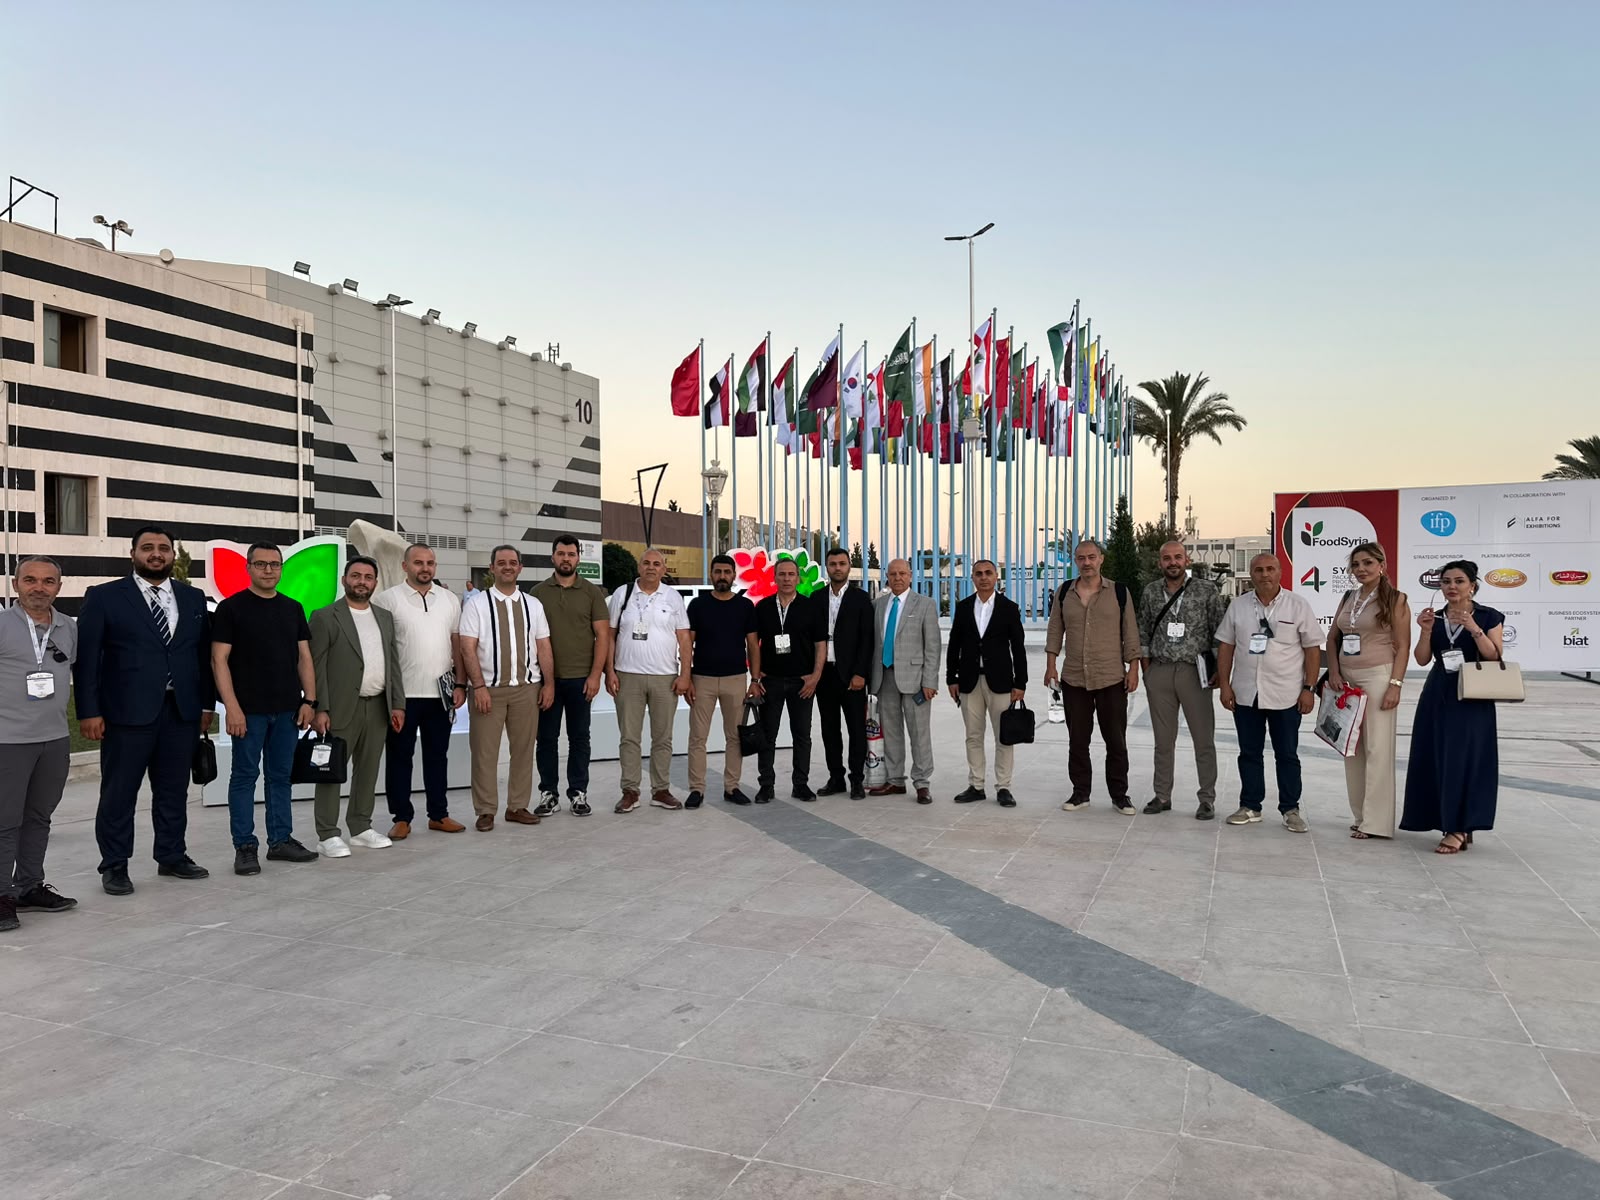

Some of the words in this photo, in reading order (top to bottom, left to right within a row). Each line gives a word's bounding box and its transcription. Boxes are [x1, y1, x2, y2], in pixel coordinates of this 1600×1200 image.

[575, 398, 593, 425] 10
[1430, 512, 1451, 533] ifp
[1312, 536, 1369, 548] FoodSyria
[1563, 635, 1589, 646] biat
